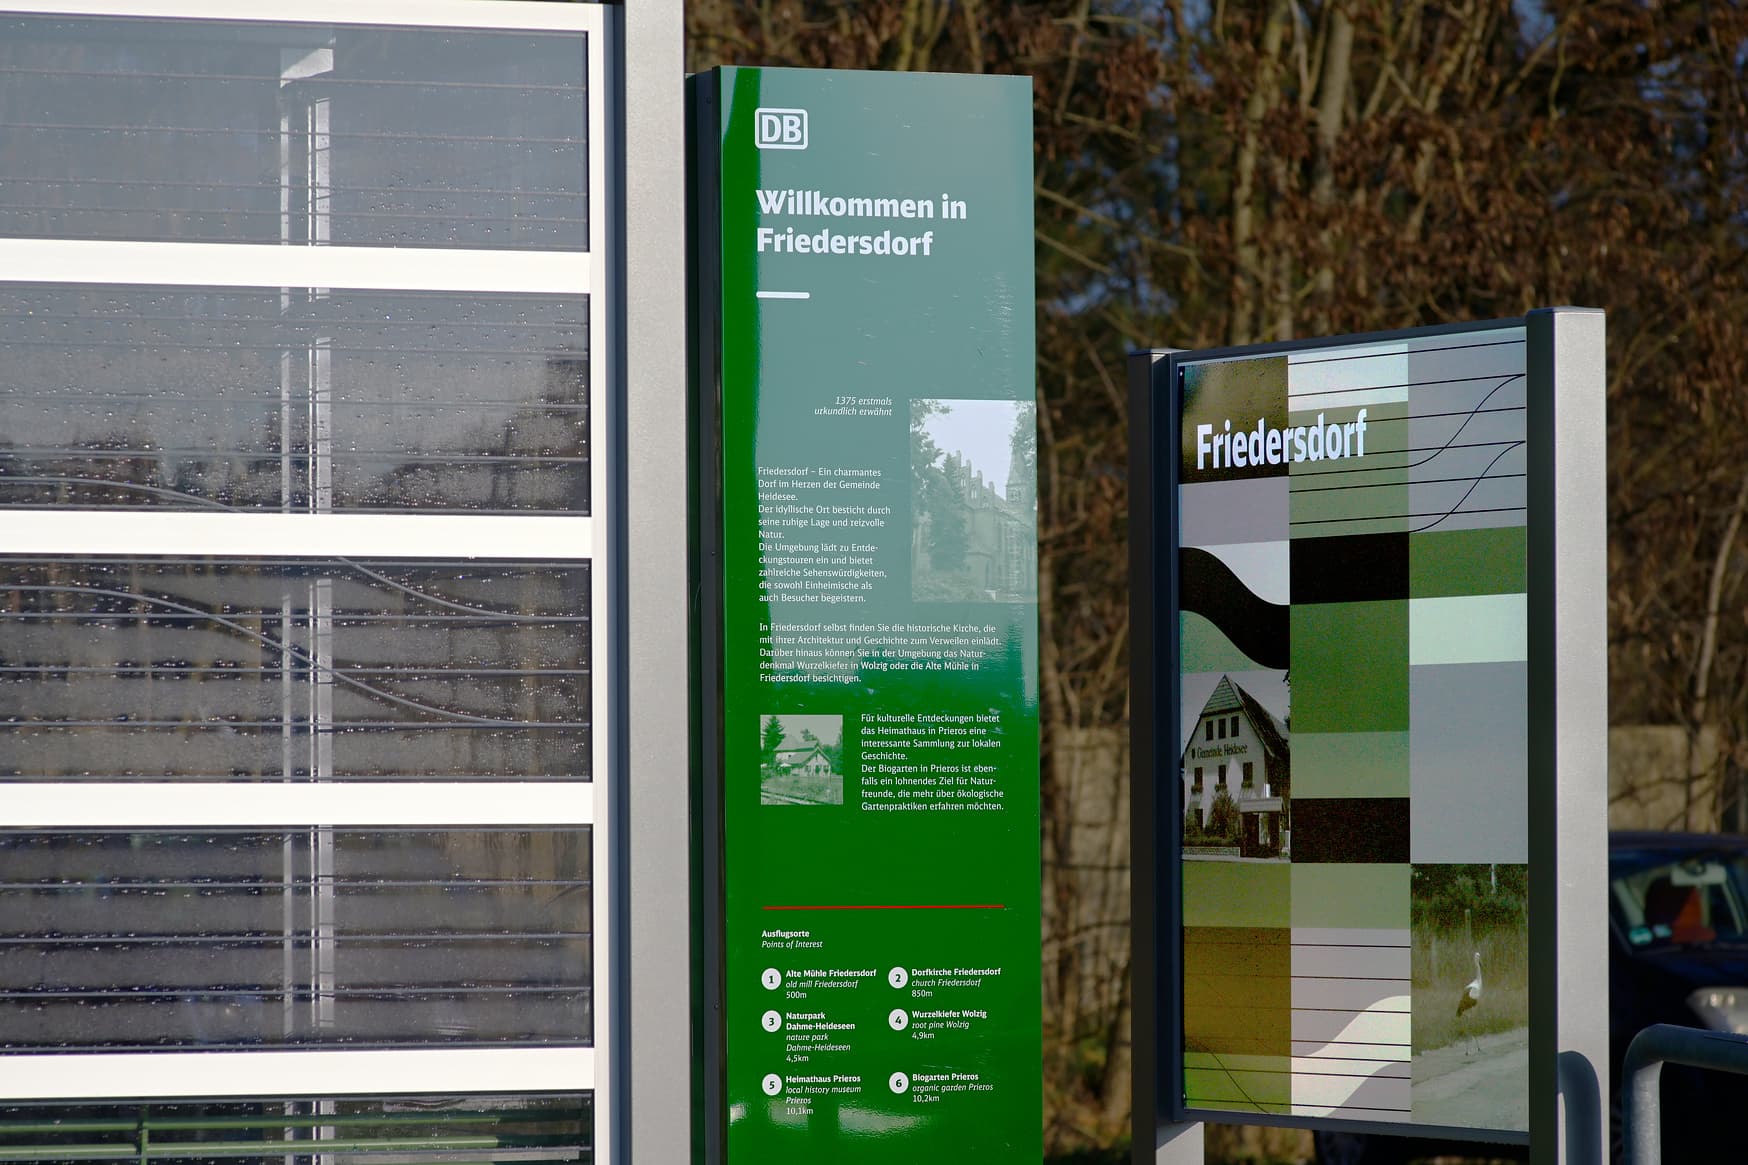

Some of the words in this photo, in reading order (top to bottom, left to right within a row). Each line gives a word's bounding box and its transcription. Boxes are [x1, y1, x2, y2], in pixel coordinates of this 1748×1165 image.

[755, 189, 934, 218] Willkommen
[942, 193, 967, 219] in
[757, 227, 934, 256] Friedersdorf
[835, 396, 856, 405] 1375
[858, 397, 892, 406] erstmals
[814, 407, 857, 415] urkundlich
[859, 407, 892, 416] erwähnt
[1196, 408, 1367, 470] Friedersdorf
[758, 466, 808, 476] Friedersdorf
[818, 467, 832, 476] Ein
[833, 468, 882, 477] charmantes
[758, 479, 777, 489] Dorf
[778, 480, 789, 488] im
[791, 480, 821, 488] Herzen
[823, 480, 837, 489] der
[839, 480, 880, 489] Gemeinde
[758, 492, 798, 501] Heidesee.
[758, 504, 774, 514] Der
[775, 505, 814, 515] idyllische
[815, 505, 830, 514] Ort
[832, 505, 865, 514] besticht
[867, 506, 891, 515] durch
[758, 517, 780, 526] seine
[782, 518, 809, 528] ruhige
[810, 518, 830, 528] Lage
[832, 518, 848, 527] und
[850, 518, 885, 527] reizvolle
[758, 530, 785, 539] Natur.
[758, 542, 773, 551] Die
[775, 543, 819, 553] Umgebung
[821, 543, 837, 552] lädt
[851, 543, 878, 552] Entde-
[758, 555, 814, 566] ckungstouren
[816, 556, 829, 564] ein
[831, 556, 847, 564] und
[849, 556, 873, 565] bietet
[758, 568, 801, 577] zahlreiche
[803, 568, 887, 578] Sehenswürdigkeiten,
[758, 581, 772, 590] die
[773, 581, 803, 589] sowohl
[805, 581, 859, 590] Einheimische
[861, 581, 873, 589] als
[758, 593, 779, 602] auch
[781, 593, 819, 602] Besucher
[821, 593, 866, 604] begeistern.
[759, 622, 768, 631] In
[770, 622, 821, 632] Friedersdorf
[823, 623, 847, 632] selbst
[849, 623, 875, 632] finden
[877, 623, 890, 632] Sie
[891, 624, 905, 632] die
[907, 624, 951, 632] historische
[953, 624, 981, 633] Kirche,
[983, 624, 996, 633] die
[759, 660, 795, 670] denkmal
[796, 661, 848, 670] Wurzelkiefer
[850, 661, 859, 670] in
[860, 661, 888, 671] Wolzig
[889, 662, 909, 670] oder
[910, 661, 924, 670] die
[925, 661, 942, 670] Alte
[944, 661, 969, 670] Mühle
[971, 661, 979, 670] in
[760, 673, 810, 682] Friedersdorf
[812, 673, 862, 684] besichtigen.
[861, 714, 875, 722] Für
[877, 714, 915, 722] kulturelle
[917, 713, 974, 724] Entdeckungen
[976, 714, 1000, 722] bietet
[860, 726, 876, 735] das
[877, 726, 926, 735] Heimathaus
[928, 726, 936, 734] in
[938, 726, 967, 735] Prieros
[969, 726, 986, 735] eine
[861, 739, 911, 748] interessante
[913, 739, 955, 749] Sammlung
[972, 739, 1001, 748] lokalen
[861, 751, 908, 760] Geschichte.
[861, 764, 876, 773] Der
[878, 764, 918, 774] Biogarten
[920, 764, 928, 772] in
[930, 764, 959, 773] Prieros
[961, 764, 971, 773] ist
[973, 764, 996, 773] eben-
[861, 776, 878, 785] falls
[880, 777, 893, 785] ein
[895, 777, 936, 785] lohnendes
[939, 776, 954, 785] Ziel
[956, 777, 968, 785] für
[970, 777, 996, 785] Natur-
[861, 789, 896, 798] freunde,
[897, 790, 910, 798] die
[912, 790, 934, 798] mehr
[936, 789, 955, 798] über
[956, 789, 1004, 799] ökologische
[861, 802, 928, 812] Gartenpraktiken
[929, 802, 964, 810] erfahren
[966, 802, 1004, 810] möchten.
[761, 929, 810, 939] Ausflugsorte
[761, 940, 784, 948] Points
[786, 940, 794, 949] of
[795, 940, 823, 948] Interest
[786, 970, 802, 978] Alte
[829, 969, 877, 977] Friedersdorf
[911, 968, 952, 976] Dorfkirche
[953, 967, 1001, 976] Friedersdorf
[785, 980, 798, 988] old
[799, 980, 813, 988] mill
[814, 980, 858, 989] Friedersdorf
[911, 979, 936, 987] church
[937, 978, 981, 987] Friedersdorf
[786, 991, 807, 999] 500m
[911, 989, 933, 998] 850m
[786, 1012, 826, 1021] Naturpark
[911, 1010, 960, 1018] Wurzelkiefer
[961, 1010, 987, 1019] Wolzig
[786, 1022, 856, 1030] Dahme-Heideseen
[928, 1021, 944, 1030] pine
[946, 1020, 970, 1029] Wolzig
[811, 1033, 828, 1042] park
[912, 1032, 935, 1040] 4,9km
[786, 1043, 851, 1052] Dahme-Heideseen
[786, 1054, 809, 1062] 4,5km
[786, 1075, 832, 1083] Heimathaus
[912, 1074, 950, 1083] Biogarten
[785, 1086, 804, 1094] local
[804, 1086, 830, 1094] history
[912, 1084, 940, 1093] organic
[941, 1084, 967, 1093] garden
[968, 1083, 994, 1091] Prieros
[785, 1096, 812, 1105] Prieros
[913, 1094, 940, 1103] 10,2km
[787, 1106, 814, 1116] 10,1km
